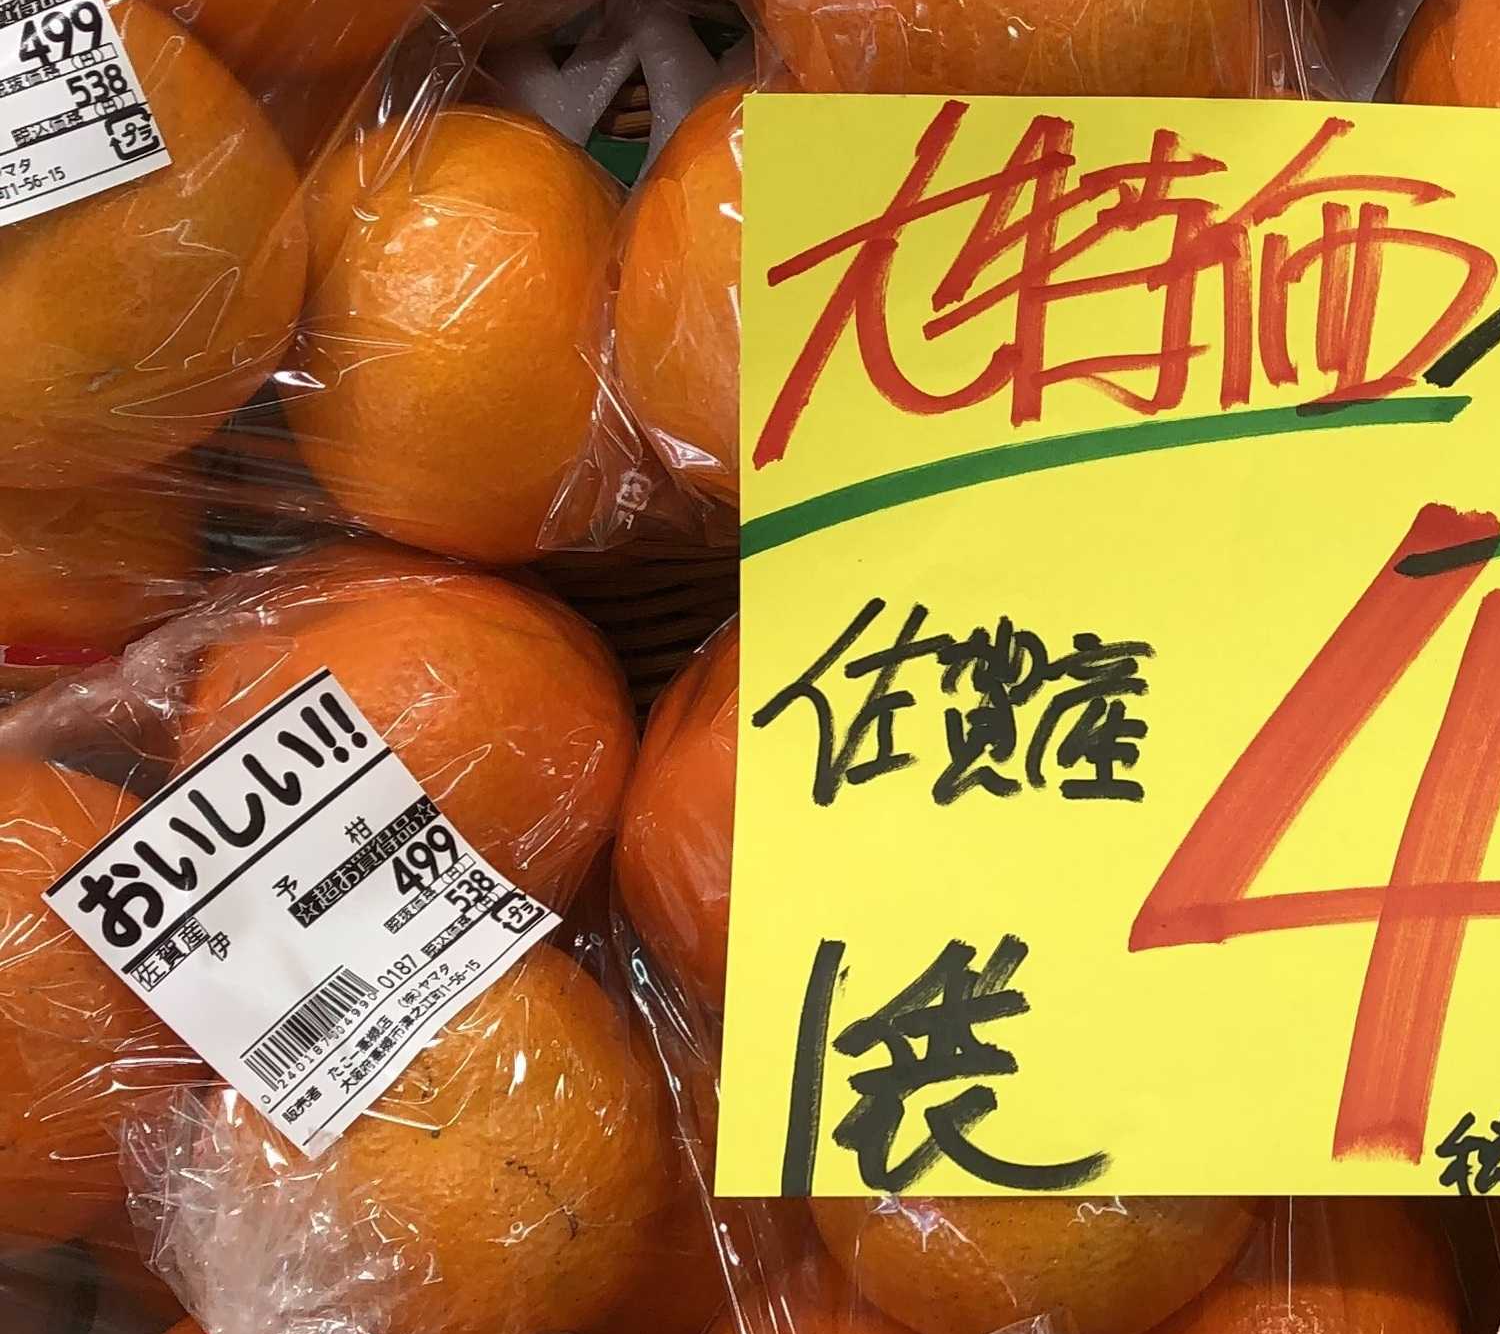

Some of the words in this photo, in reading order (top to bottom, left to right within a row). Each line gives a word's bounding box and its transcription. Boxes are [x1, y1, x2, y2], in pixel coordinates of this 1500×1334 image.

[19, 1, 103, 67] 499
[66, 64, 128, 108] 538
[122, 122, 152, 147] プラ
[0, 158, 31, 177] マタ
[753, 599, 1156, 807] 佐賀産
[77, 692, 368, 948] おいしい!!
[392, 825, 458, 895] 499
[444, 869, 495, 913] 538
[130, 918, 210, 992] 佐賀産
[377, 954, 418, 989] 0187
[282, 1085, 322, 1124] 販売者
